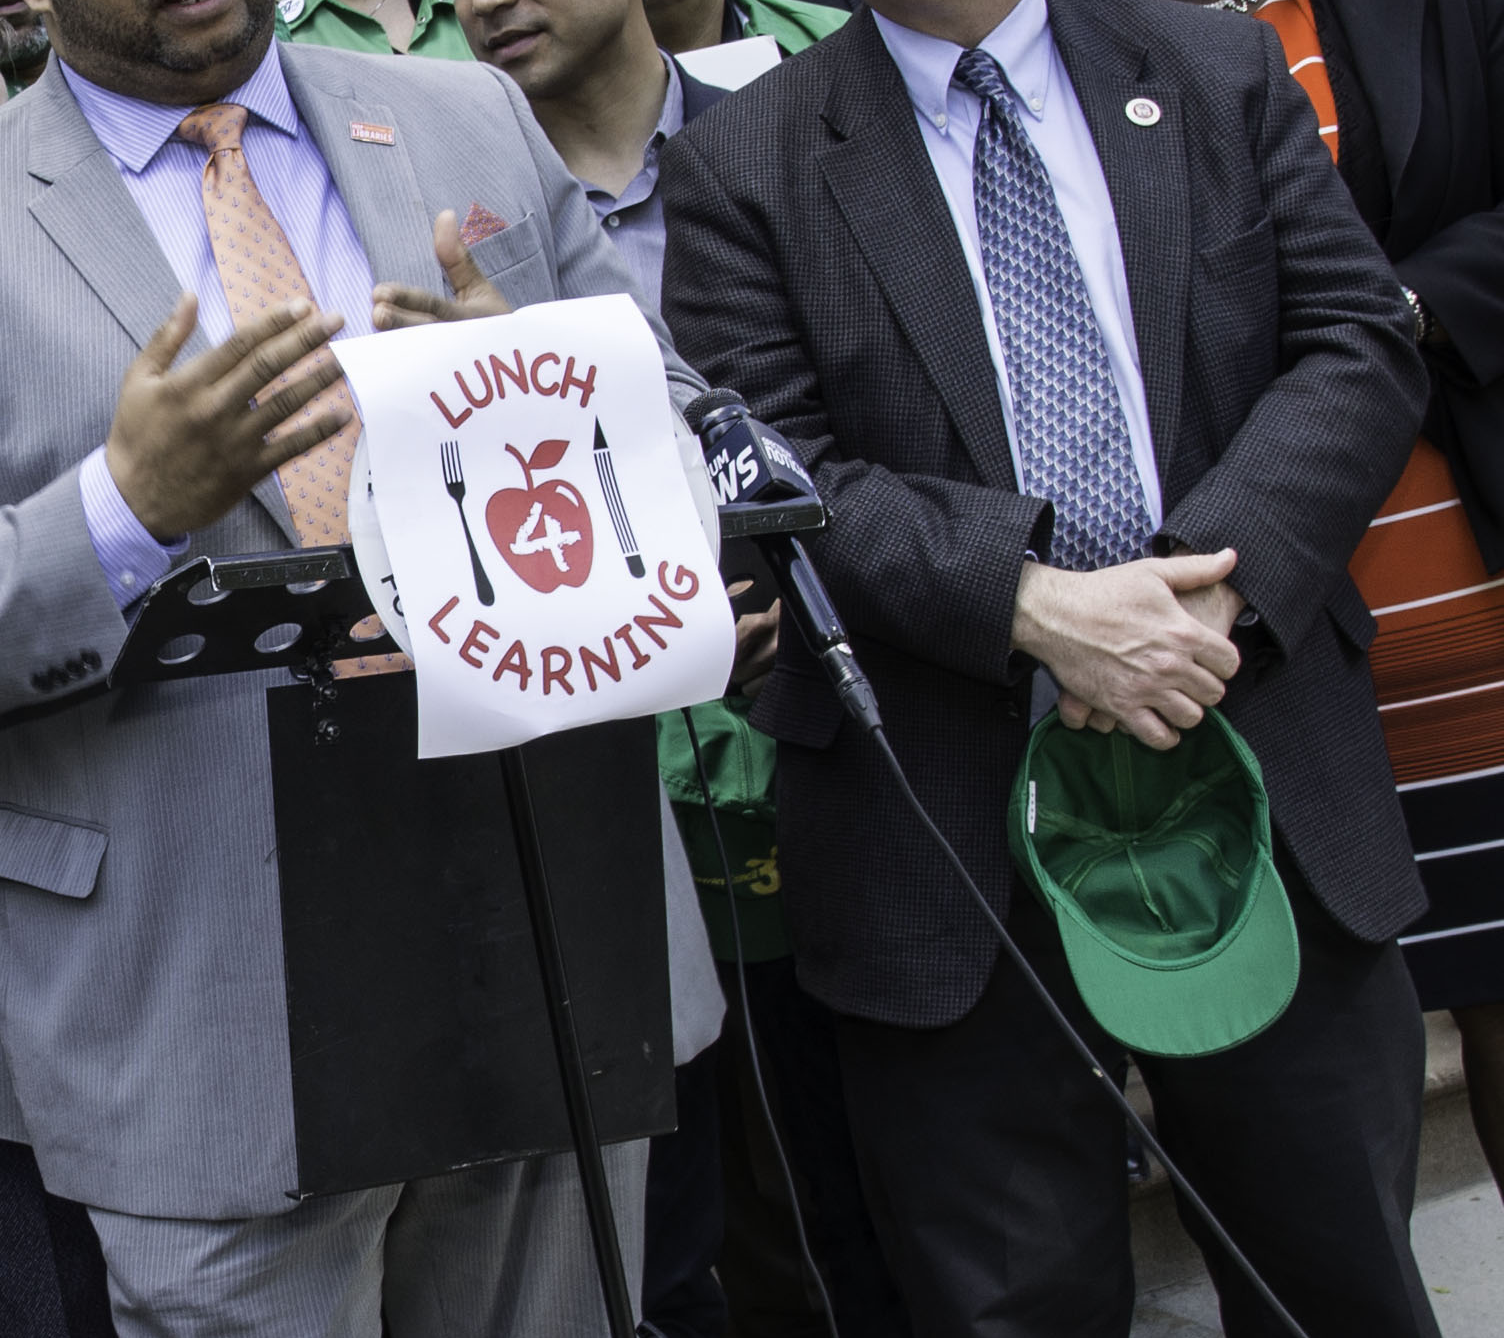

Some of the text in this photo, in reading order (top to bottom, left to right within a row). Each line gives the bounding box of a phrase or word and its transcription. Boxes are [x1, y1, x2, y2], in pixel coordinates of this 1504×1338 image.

[429, 348, 598, 430] LUNCH
[508, 501, 582, 574] 4
[427, 558, 701, 697] LEARNING
